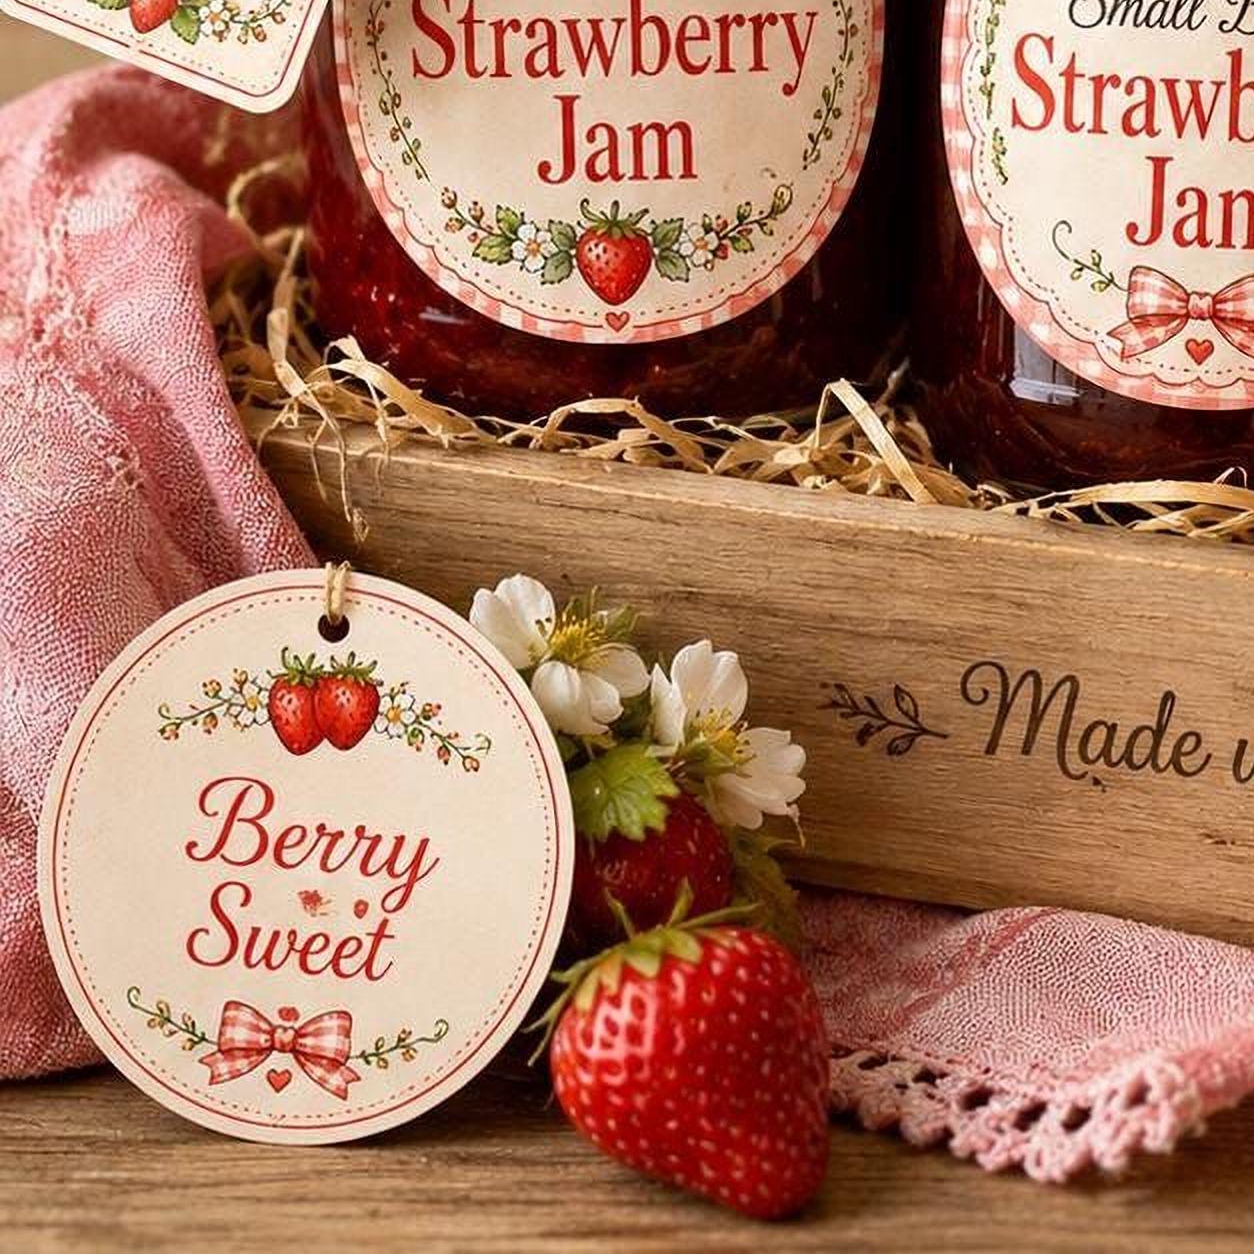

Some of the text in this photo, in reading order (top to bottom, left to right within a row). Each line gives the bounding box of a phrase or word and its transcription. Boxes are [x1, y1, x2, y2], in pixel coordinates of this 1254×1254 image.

[537, 94, 698, 186] Jam
[960, 661, 1212, 781] Made
[185, 776, 440, 914] Berry
[186, 881, 396, 981] Sweet
